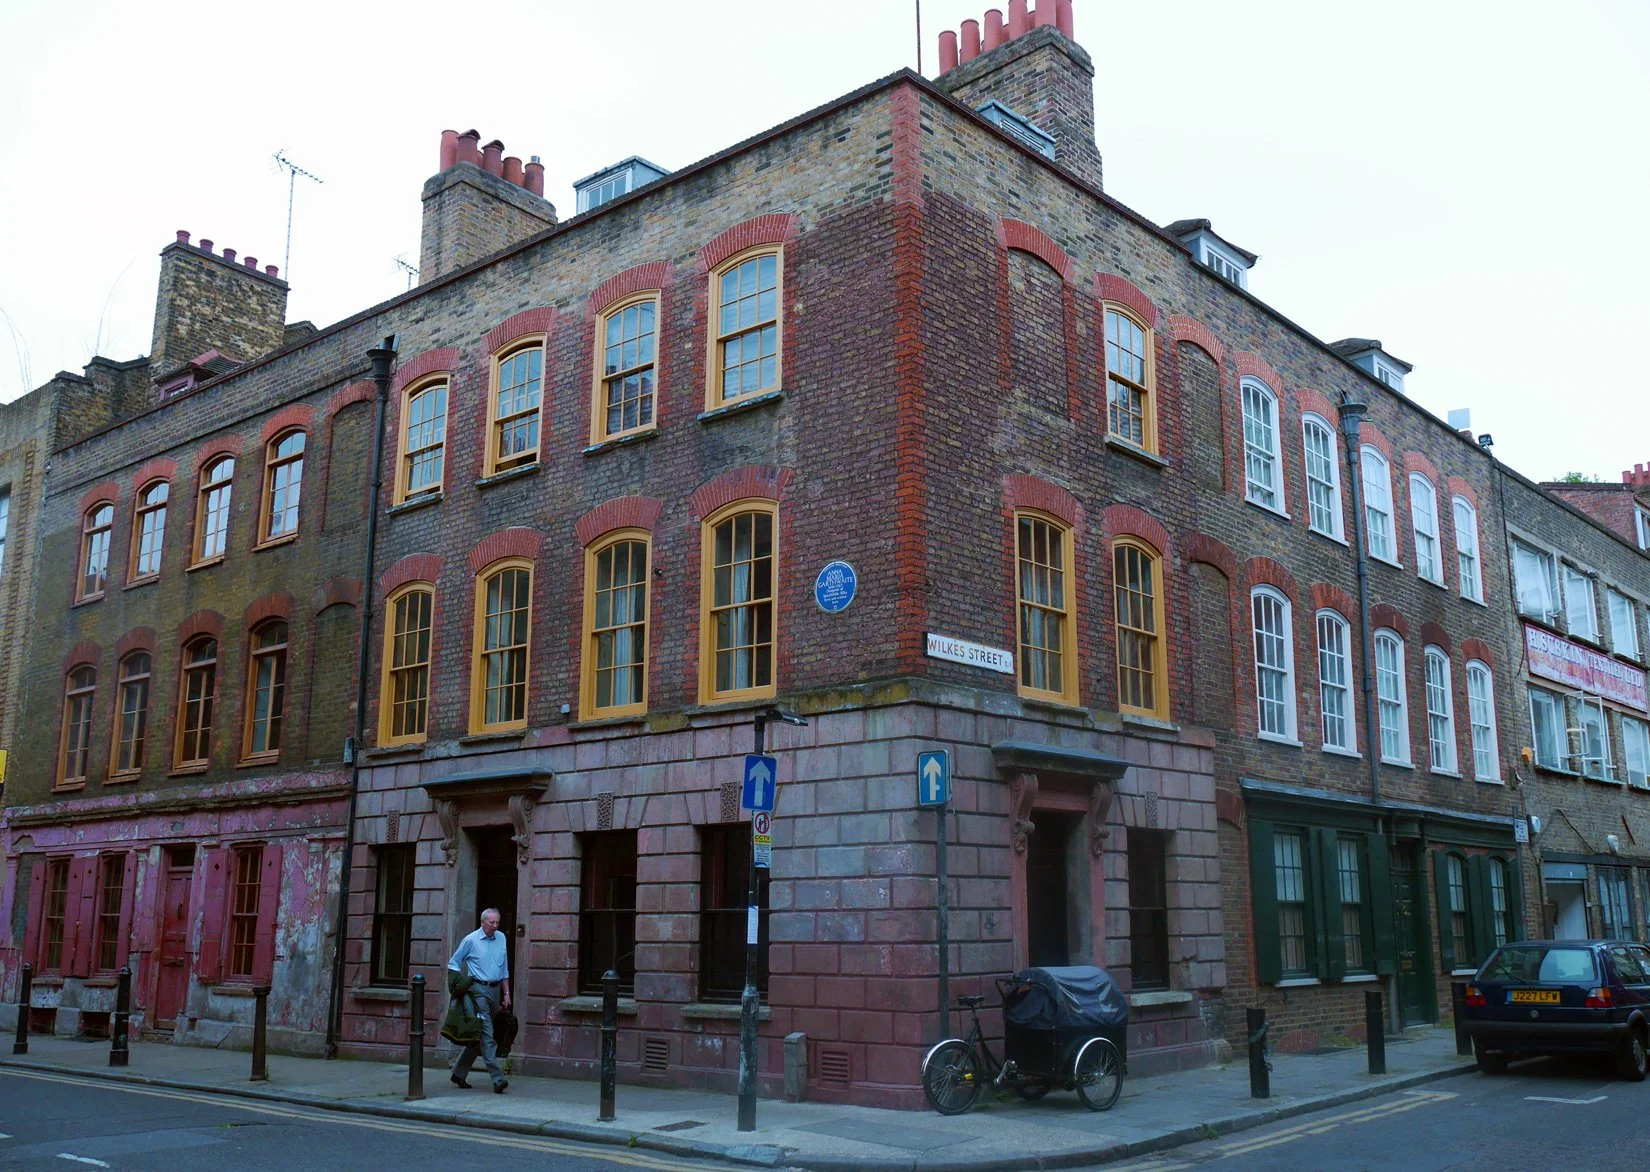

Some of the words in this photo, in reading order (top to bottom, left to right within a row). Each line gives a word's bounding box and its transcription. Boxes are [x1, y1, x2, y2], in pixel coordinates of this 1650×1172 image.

[927, 638, 965, 658] WILKES
[968, 648, 1003, 666] STREET
[1513, 992, 1537, 1000] J227
[1540, 992, 1558, 1000] LFW
